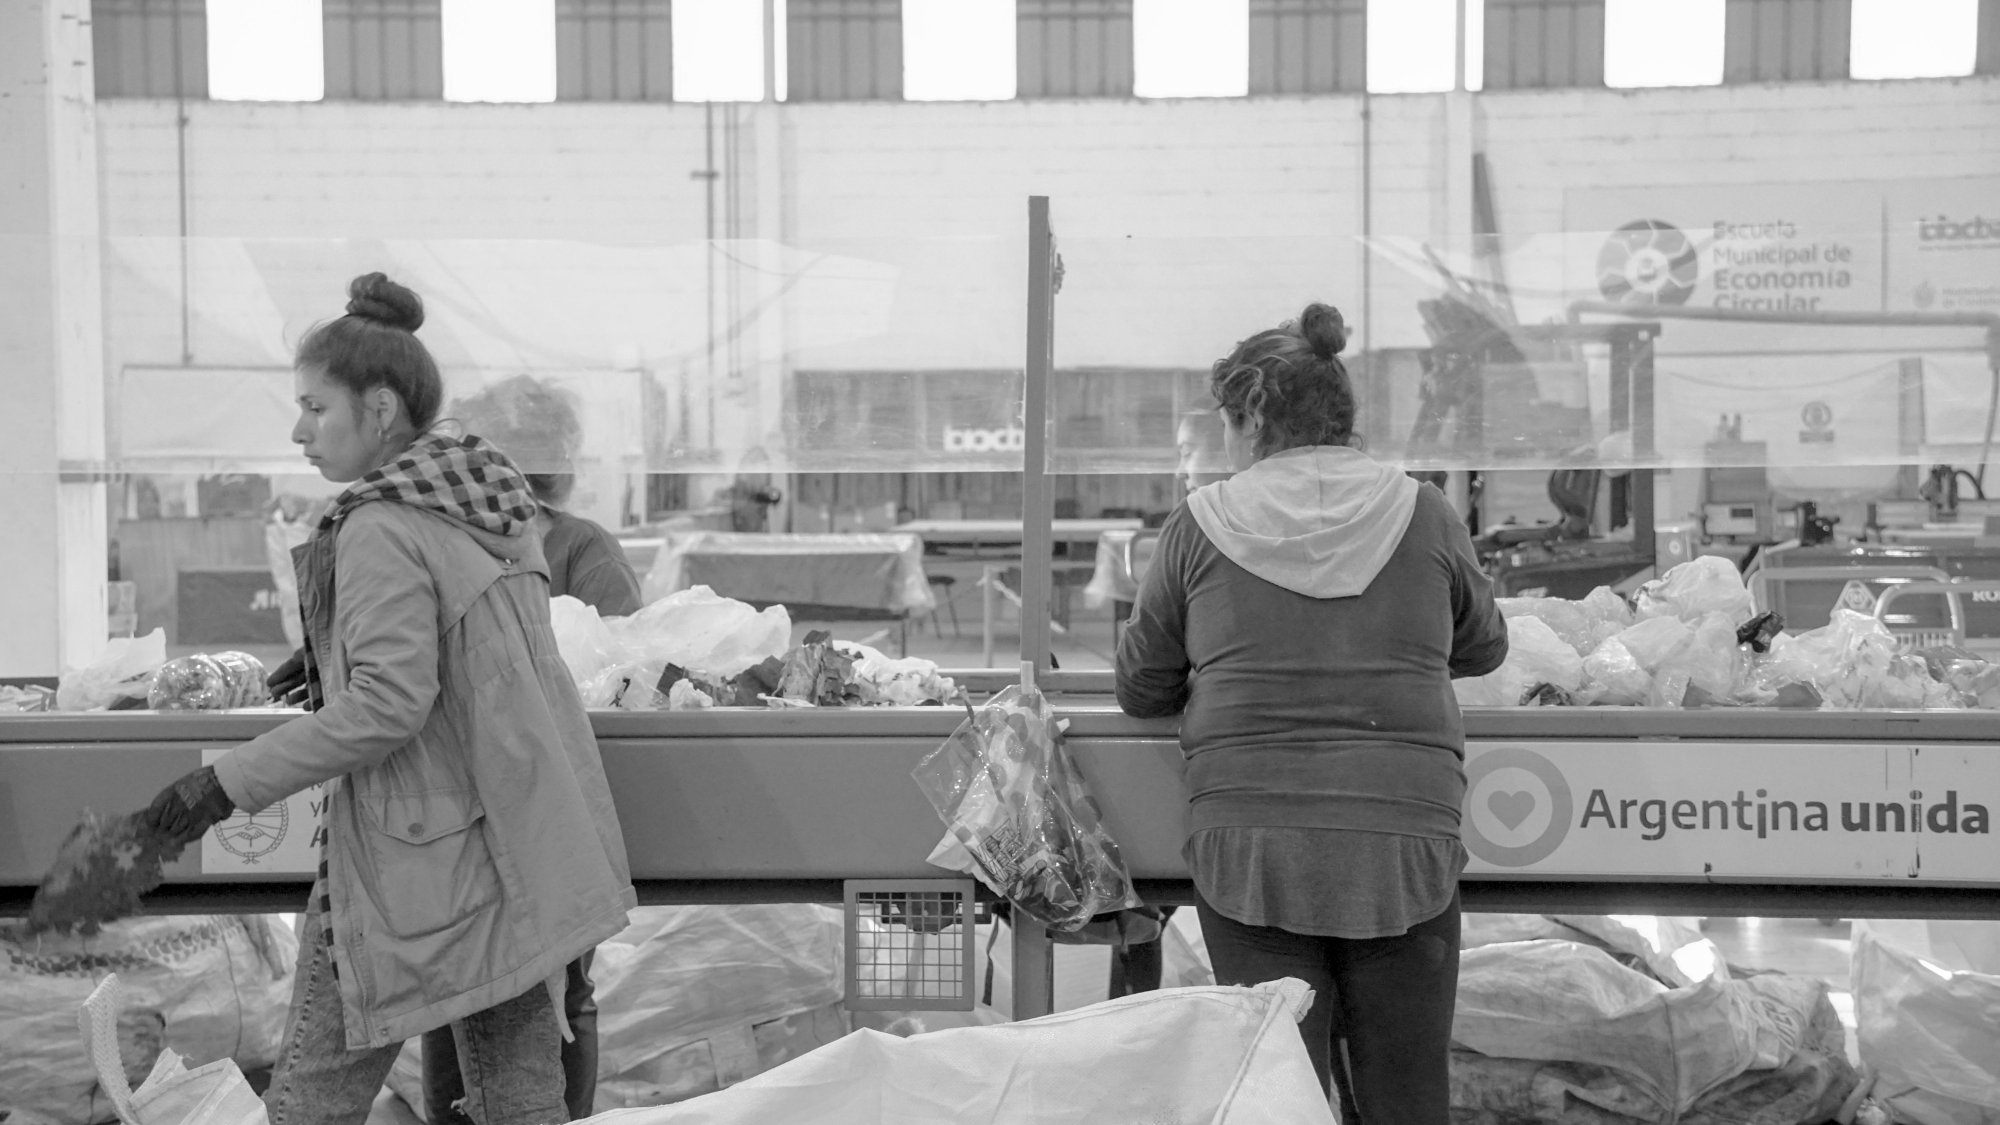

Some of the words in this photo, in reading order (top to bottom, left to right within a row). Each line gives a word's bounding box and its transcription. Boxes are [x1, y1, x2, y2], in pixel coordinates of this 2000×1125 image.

[1713, 219, 1797, 240] Escuela
[1713, 243, 1819, 268] Municipal
[1823, 242, 1852, 263] de
[1713, 266, 1851, 290] Economía
[1713, 292, 1821, 311] Circular
[1579, 788, 1829, 841] Argentina
[1841, 790, 1990, 834] unida
